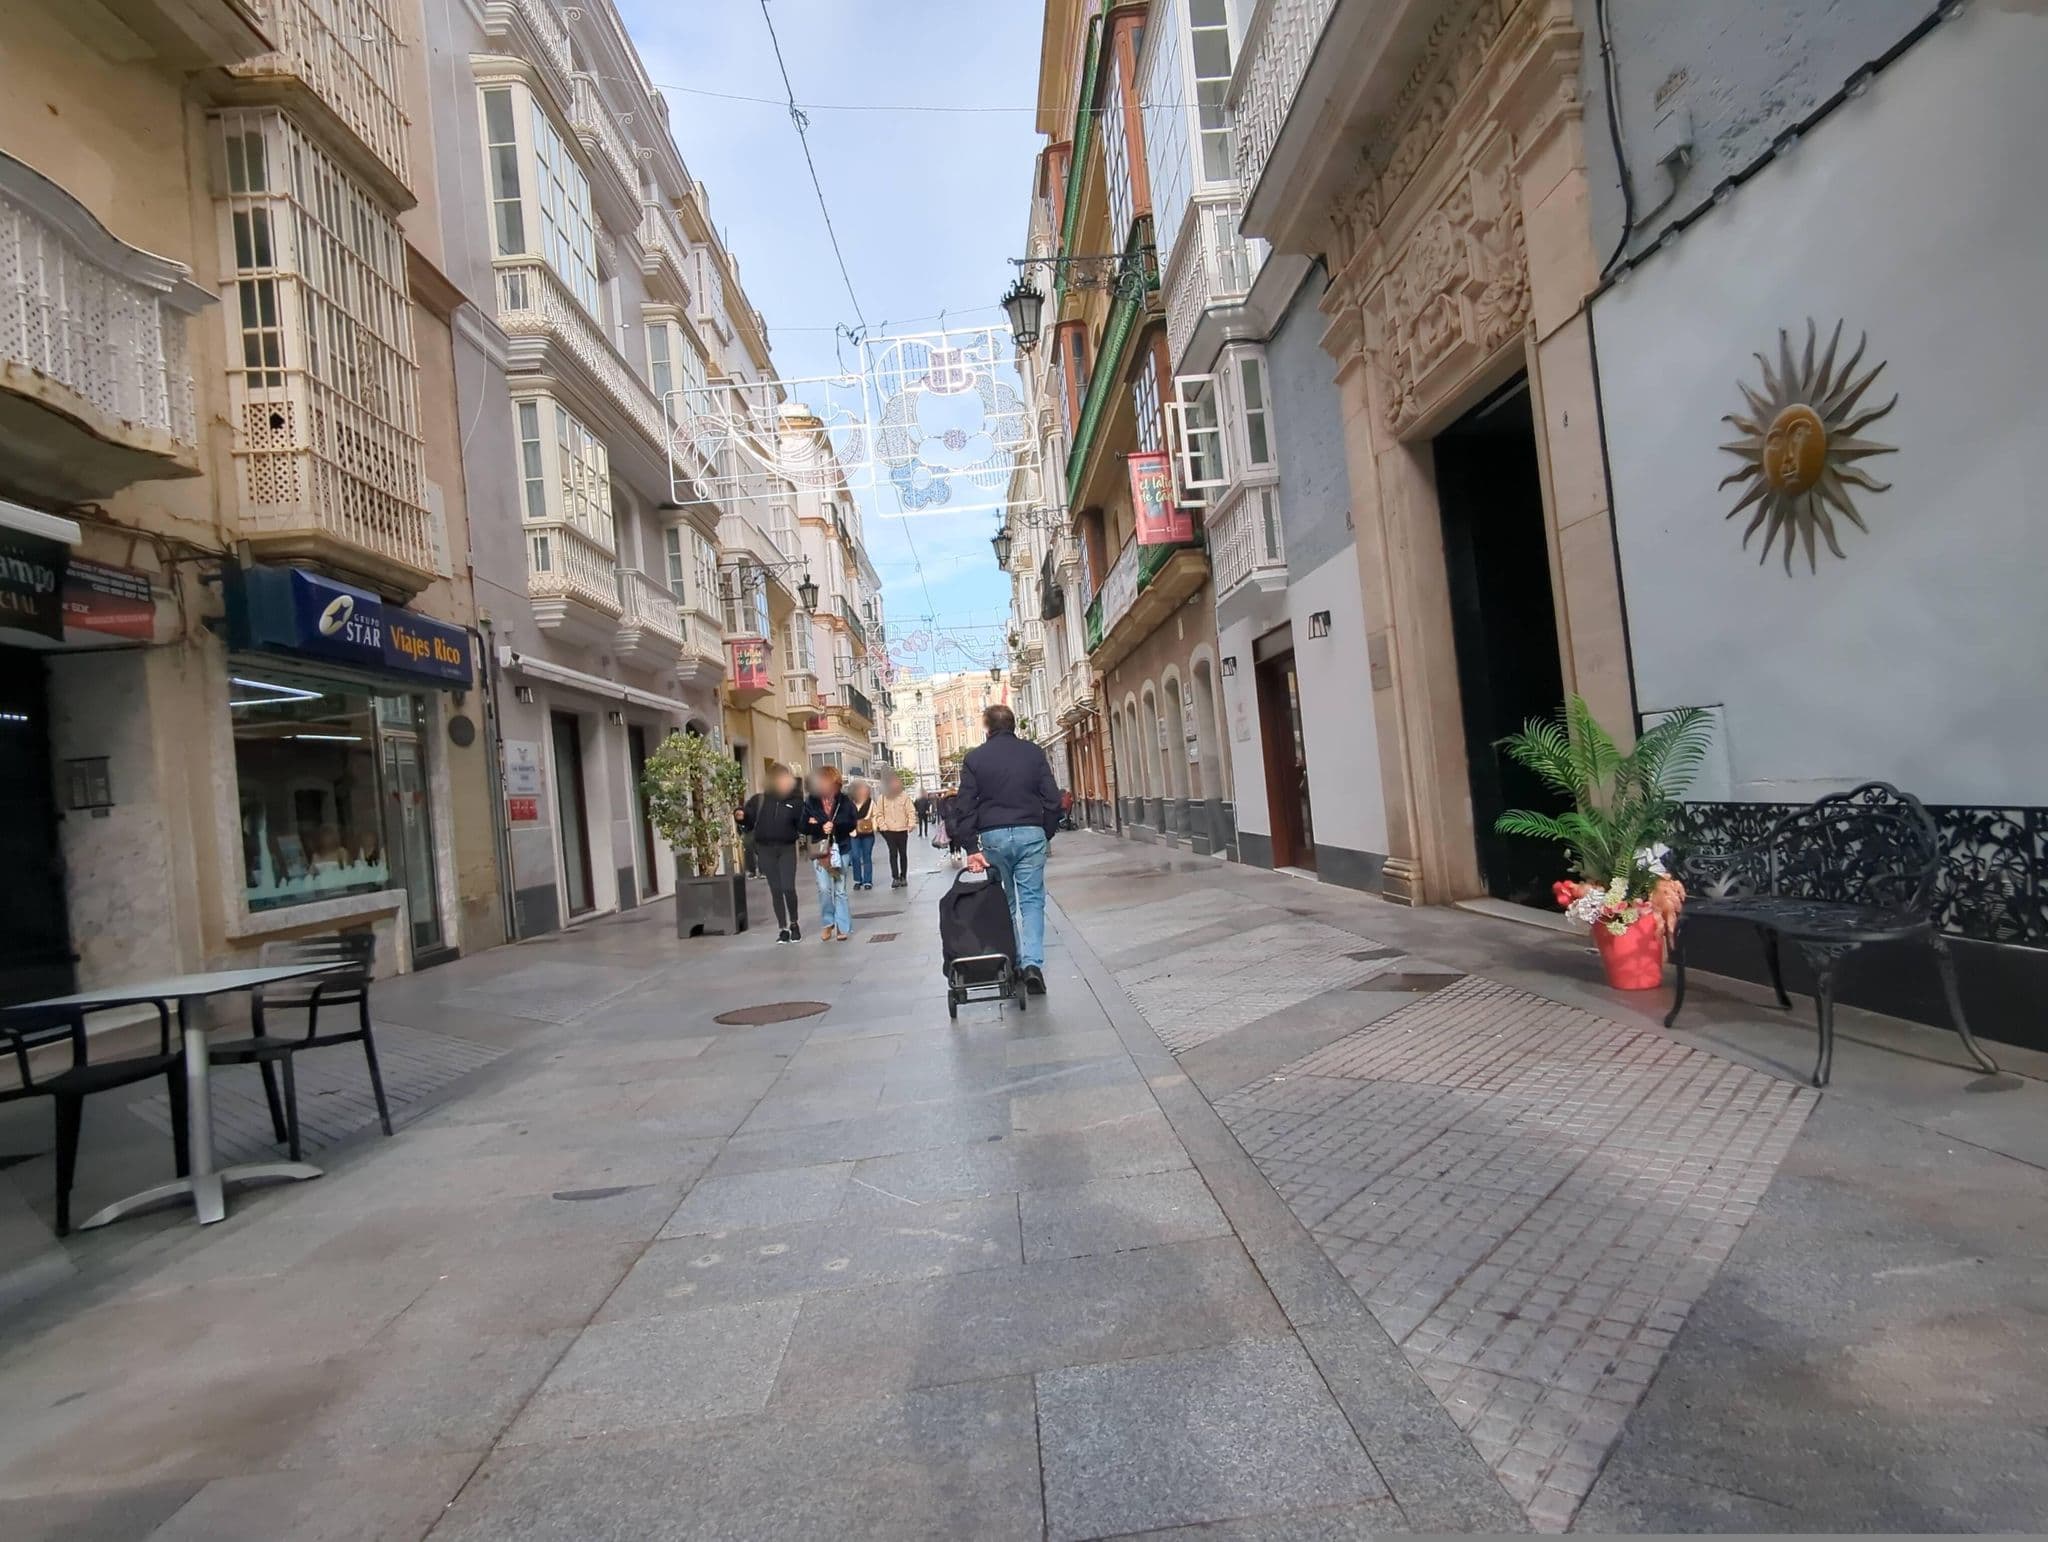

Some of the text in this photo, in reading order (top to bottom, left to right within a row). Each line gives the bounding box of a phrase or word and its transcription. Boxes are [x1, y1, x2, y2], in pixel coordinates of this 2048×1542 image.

[353, 613, 380, 627] GRUPO
[346, 621, 381, 648] STAR
[390, 624, 461, 665] Viajes Rico
